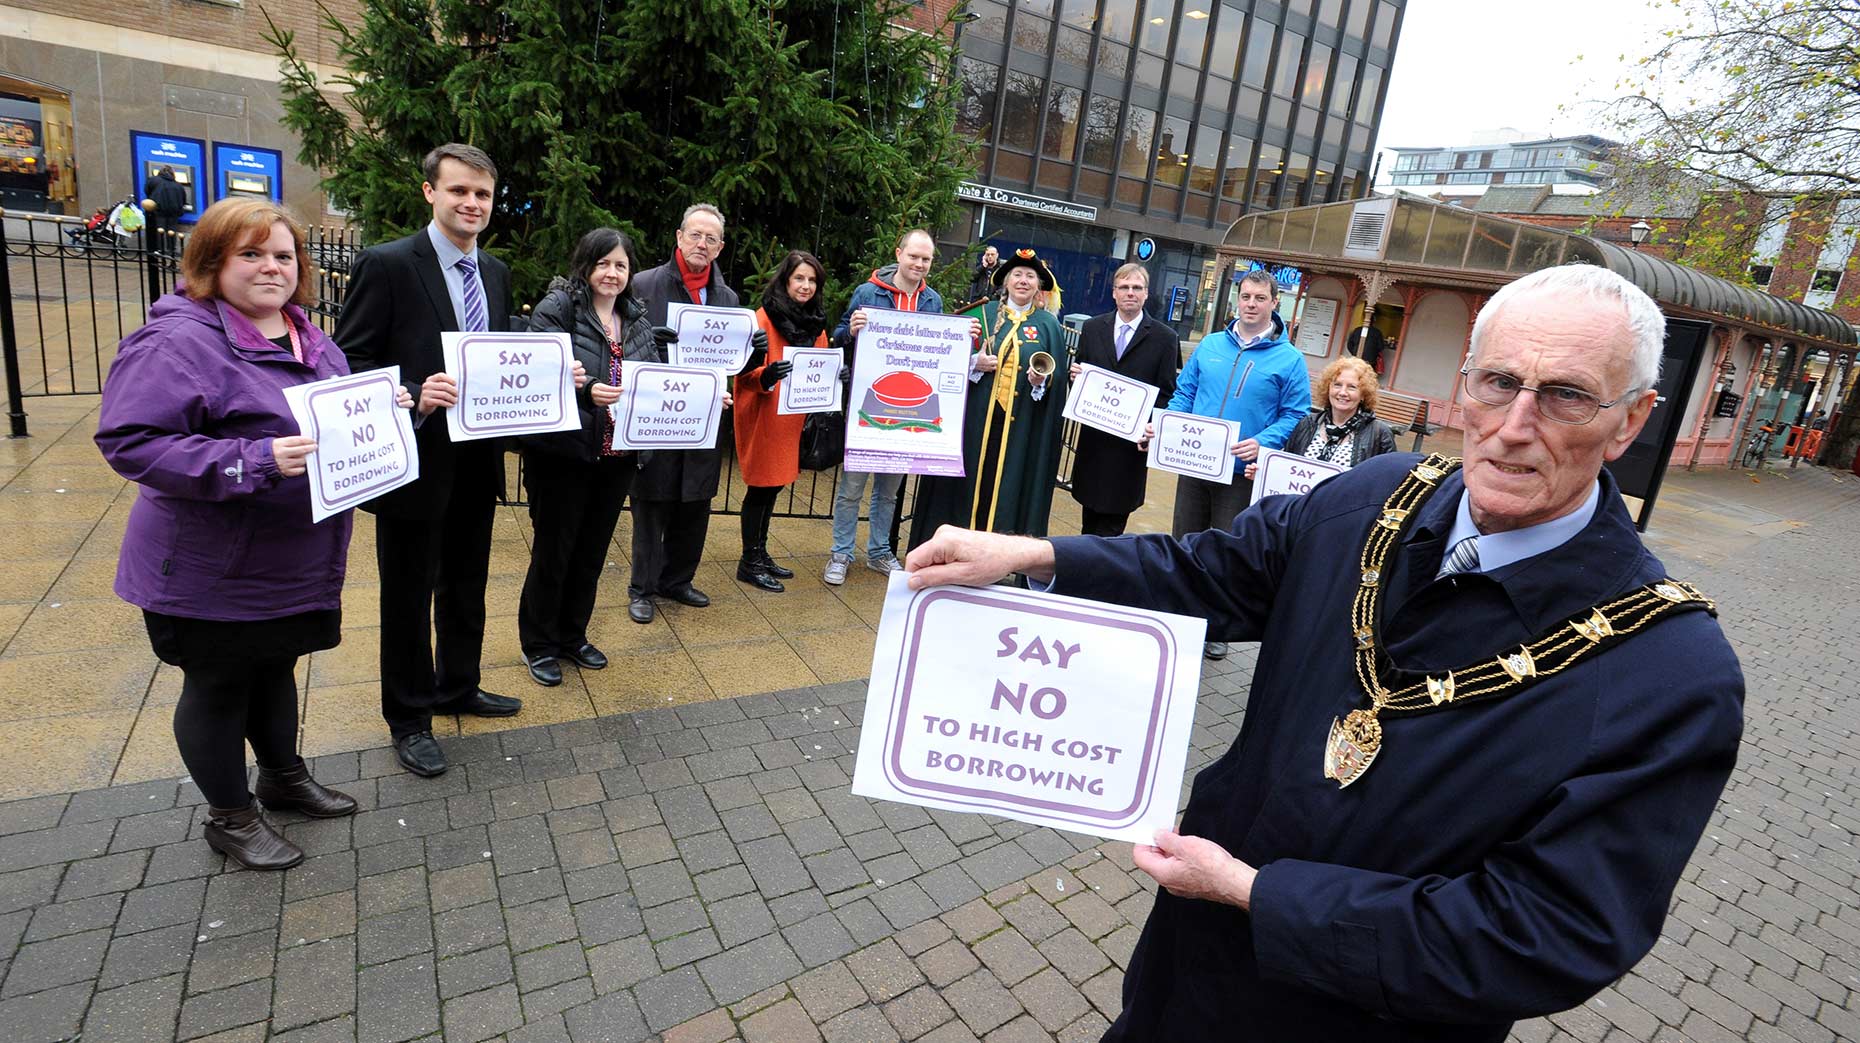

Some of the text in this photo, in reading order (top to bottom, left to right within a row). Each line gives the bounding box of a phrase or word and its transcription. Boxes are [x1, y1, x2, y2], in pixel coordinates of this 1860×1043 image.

[984, 188, 991, 198] &
[995, 190, 1008, 202] Co
[1012, 196, 1039, 208] Chartered
[1064, 207, 1093, 218] Accountants
[704, 319, 729, 330] SAY
[868, 321, 964, 340] More debt letters than
[701, 335, 724, 344] NO
[876, 337, 922, 352] Christmas
[499, 350, 532, 365] SAY
[684, 357, 734, 365] BORROWING
[808, 360, 826, 368] SAY
[500, 374, 530, 389] NO
[806, 374, 821, 383] NO
[663, 379, 690, 392] SAY
[1104, 382, 1126, 394] SAY
[472, 394, 551, 406] TO HIGH COST
[661, 400, 686, 412] NO
[1100, 394, 1120, 407] NO
[344, 397, 371, 417] SAY
[1094, 404, 1112, 414] HIGH
[1114, 412, 1131, 421] COST
[476, 409, 548, 421] BORROWING
[637, 416, 650, 424] TO
[1082, 408, 1126, 428] BORROWING
[352, 423, 375, 447] NO
[1182, 424, 1204, 435] SAY
[1181, 438, 1201, 449] NO
[328, 443, 395, 472] TO HIGH COST
[1175, 450, 1196, 458] HIGH
[1198, 454, 1216, 462] COST
[1165, 456, 1213, 470] BORROWING
[334, 461, 399, 491] BORROWING
[1290, 466, 1316, 479] SAY
[1288, 481, 1311, 494] NO
[996, 627, 1081, 670] SAY
[990, 679, 1067, 720] NO
[923, 715, 1122, 765] TO HIGH COST
[926, 750, 1104, 796] BORROWING
